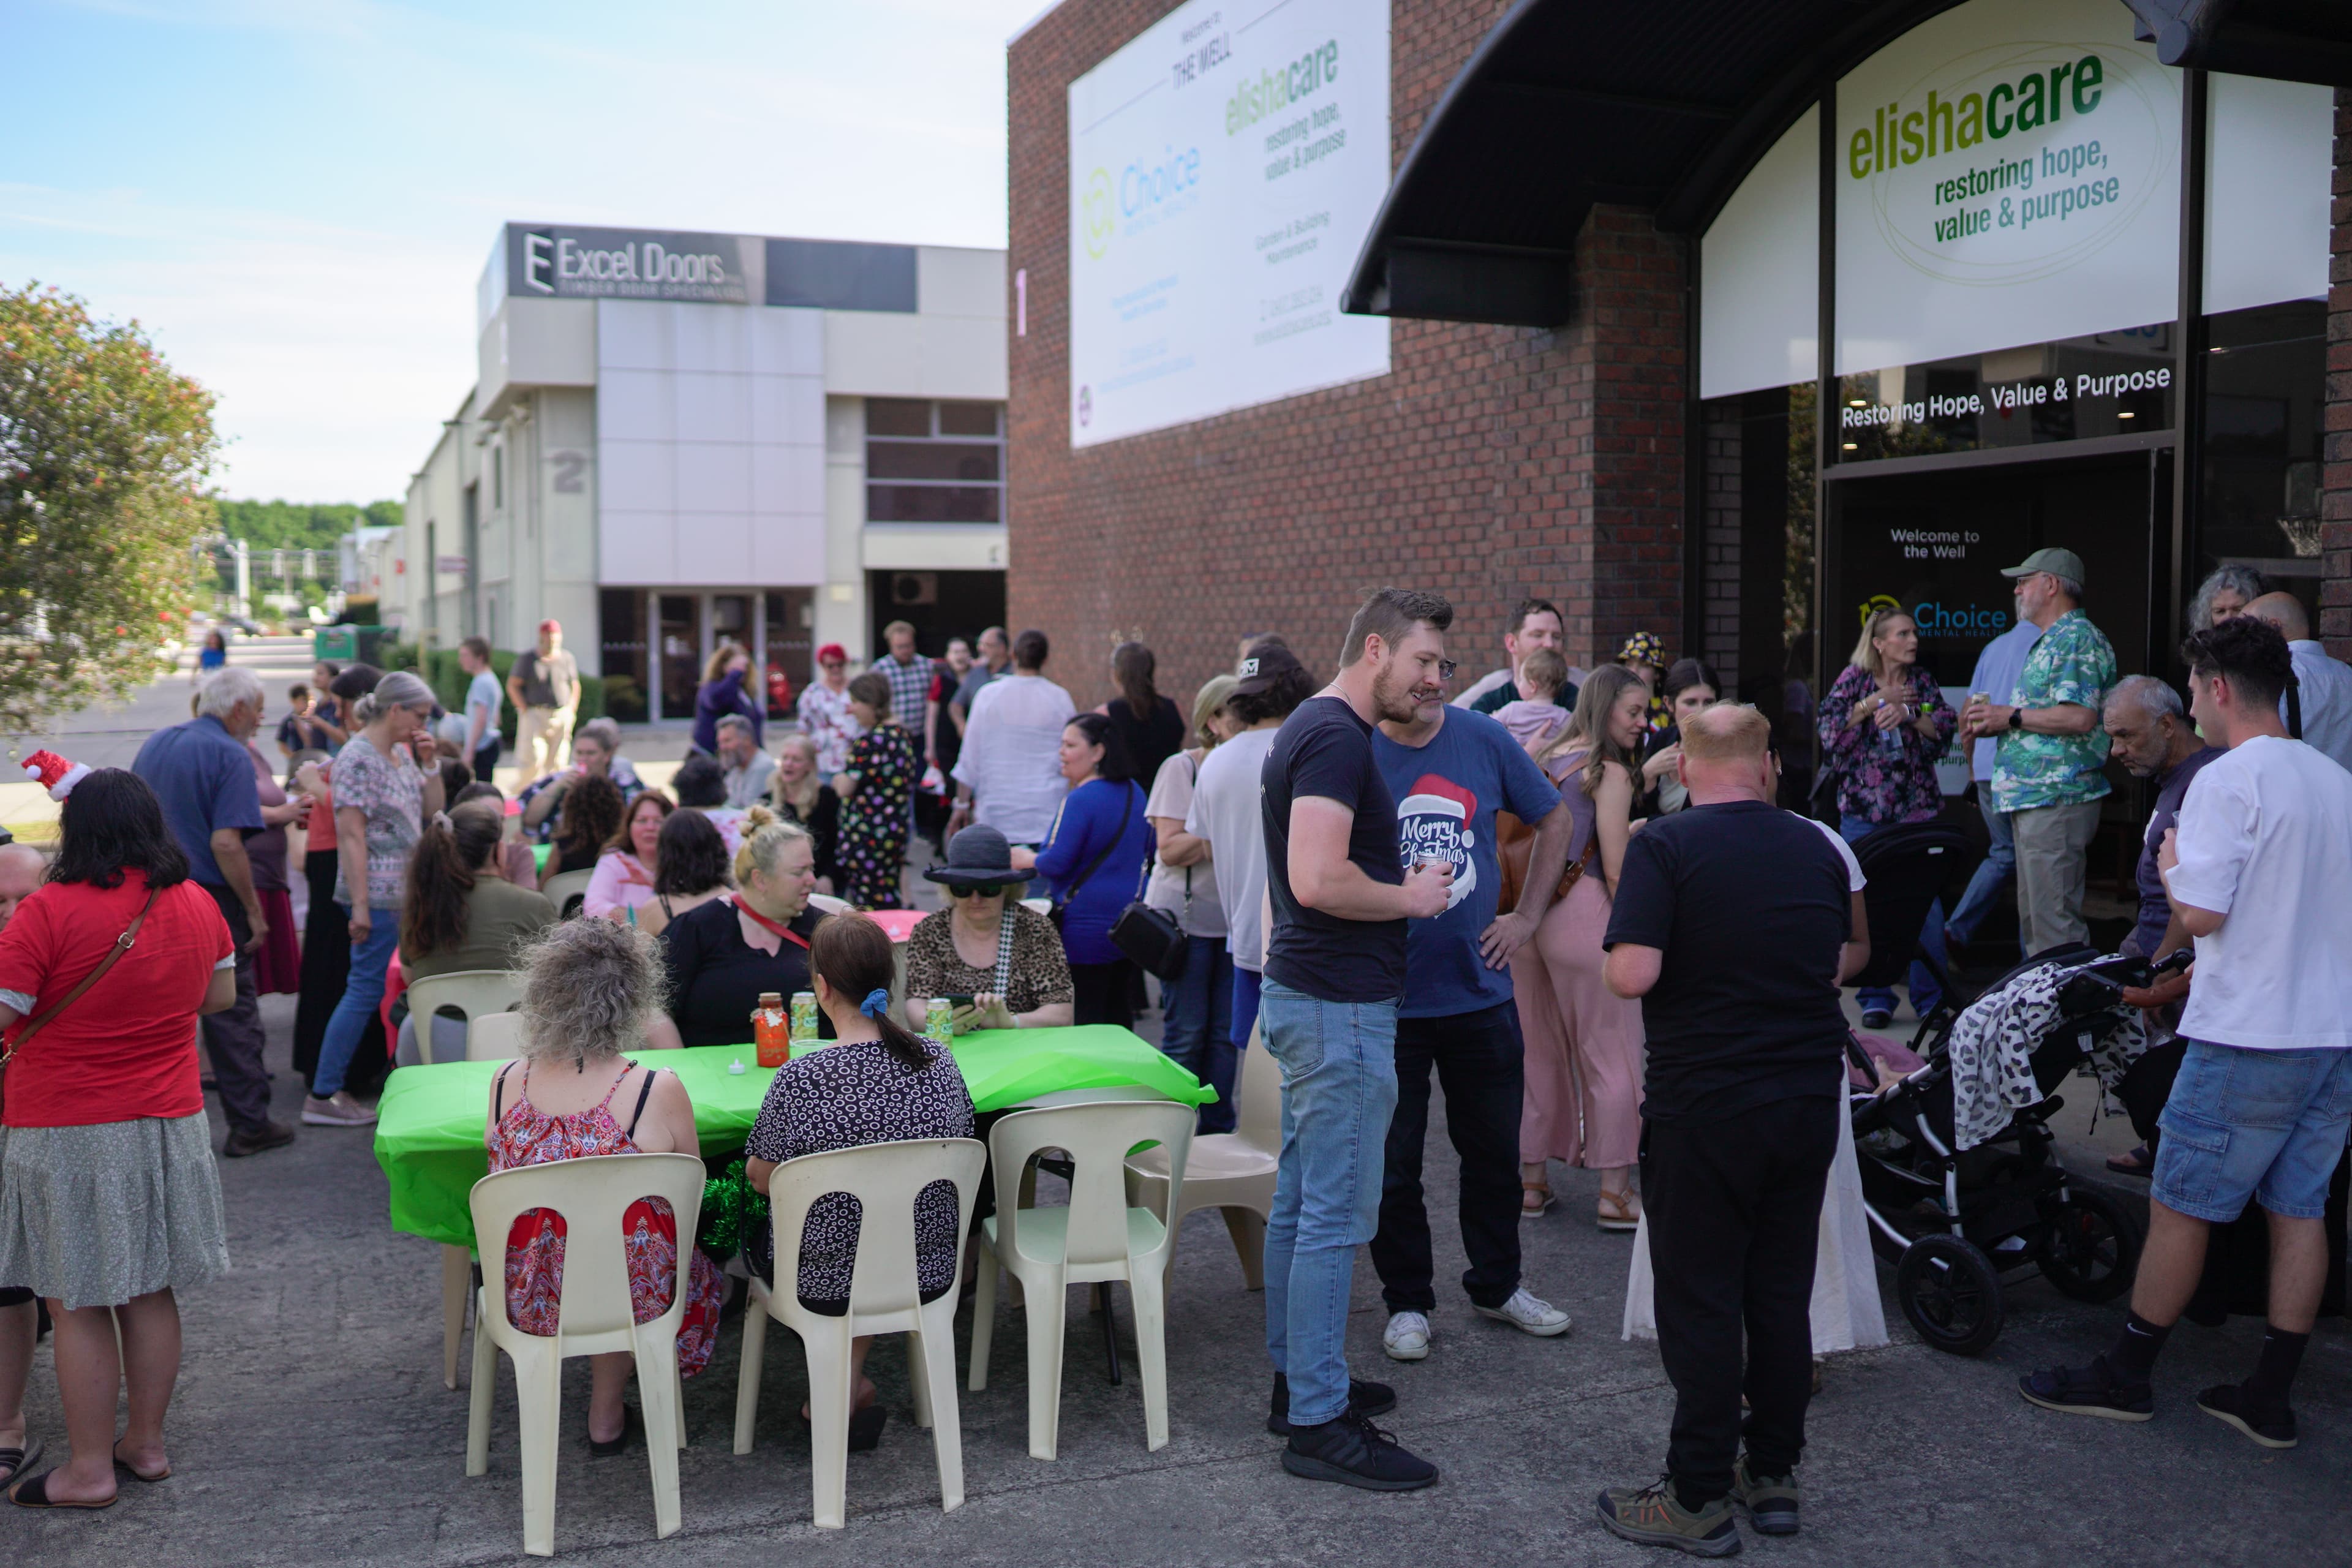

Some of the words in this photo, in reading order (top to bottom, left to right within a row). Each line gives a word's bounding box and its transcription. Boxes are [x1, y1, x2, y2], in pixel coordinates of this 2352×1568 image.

[1172, 53, 1196, 89] THE
[1197, 31, 1232, 75] WELL
[1225, 39, 1338, 137] elishacare
[1850, 55, 2103, 179] elishacare
[1120, 144, 1200, 217] Choice
[1936, 158, 2033, 205] restoring
[2042, 140, 2108, 178] hope,
[1934, 208, 1991, 243] value
[1998, 197, 2015, 227] &
[2022, 176, 2120, 230] purpose
[557, 238, 641, 281] Excel
[643, 242, 726, 284] Doors
[1842, 399, 1925, 429] Restoring
[1929, 393, 1985, 418] Hope,
[1991, 382, 2047, 409] Value
[2053, 377, 2068, 401] &
[2077, 368, 2171, 398] Purpose
[553, 451, 586, 494] 2
[1891, 529, 1960, 543] Welcome
[1965, 530, 1980, 543] to
[1904, 545, 1928, 559] the
[1932, 545, 1966, 559] Well
[1914, 601, 2007, 628] Choice
[1918, 628, 1960, 638] MENTAL
[1940, 755, 1968, 767] purp
[1401, 816, 1460, 849] Merry
